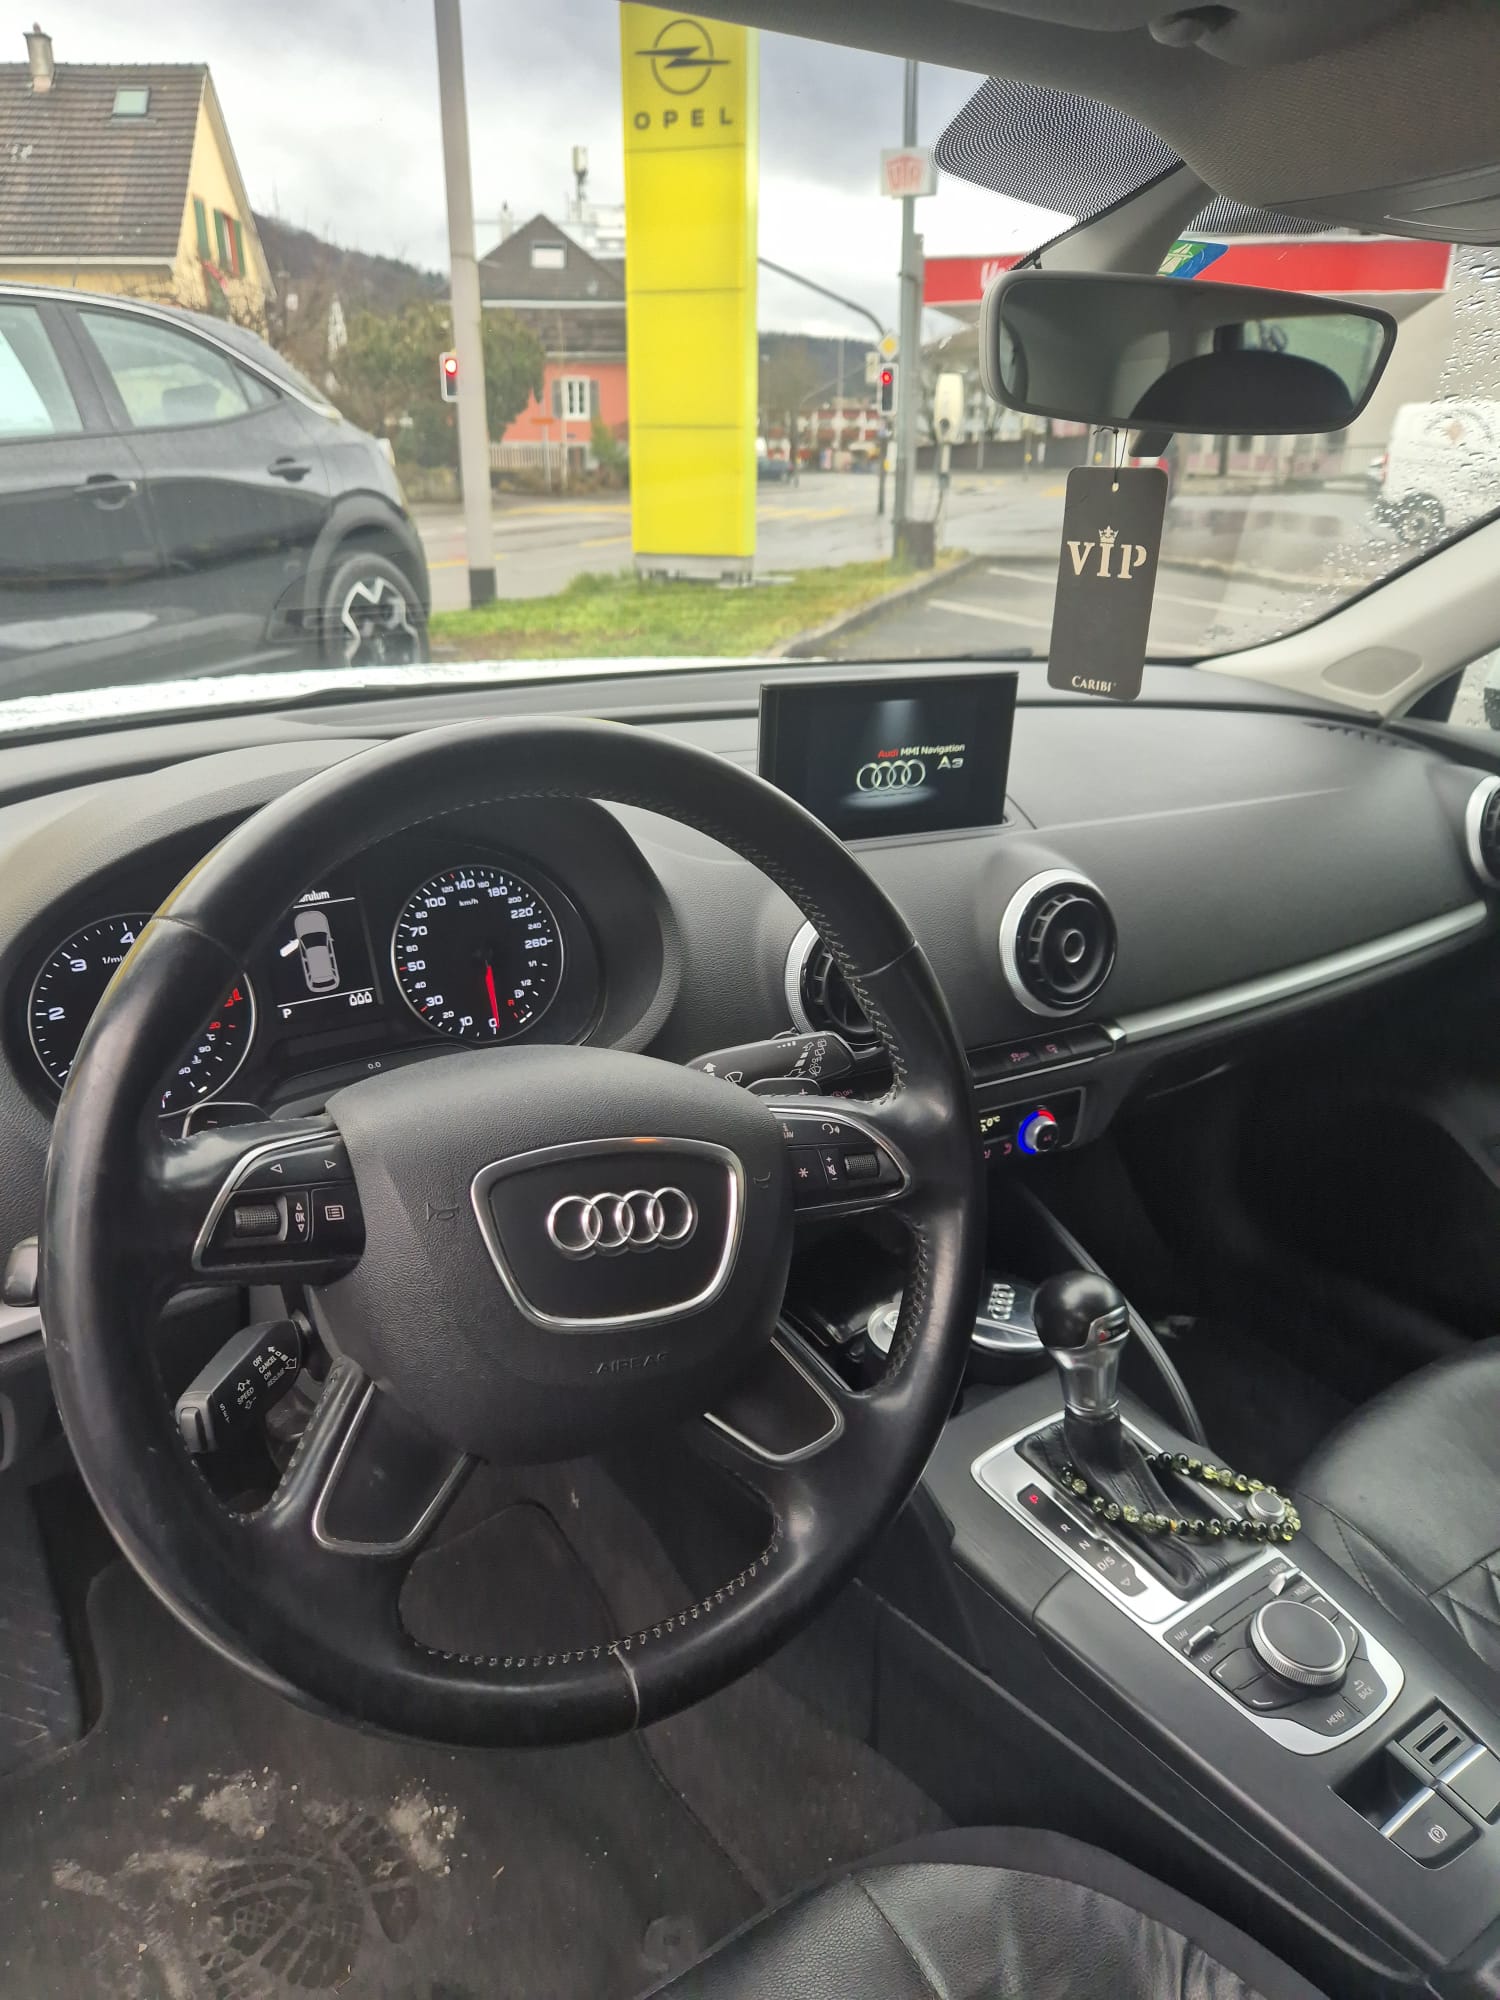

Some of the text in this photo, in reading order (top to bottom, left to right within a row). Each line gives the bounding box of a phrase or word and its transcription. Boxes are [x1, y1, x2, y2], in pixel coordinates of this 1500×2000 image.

[633, 107, 733, 130] OPEL
[1067, 541, 1147, 579] VIP
[878, 743, 966, 759] Audi MMI Navigation
[937, 755, 964, 770] A3
[455, 879, 475, 890] 140
[487, 886, 508, 897] 180
[424, 897, 447, 908] 100
[459, 898, 479, 906] km/h
[508, 896, 522, 904] 200
[510, 907, 533, 919] 220
[409, 925, 428, 937] 70
[527, 922, 542, 930] 240
[120, 931, 135, 944] 4
[524, 937, 548, 949] 260
[69, 958, 87, 972] 3
[407, 960, 426, 971] 50
[414, 981, 427, 989] 40
[426, 995, 444, 1007] 30
[48, 1006, 65, 1021] 2
[282, 1008, 292, 1019] P
[442, 1011, 454, 1019] 20
[459, 1016, 473, 1027] 10
[488, 1018, 498, 1028] 0
[295, 1212, 305, 1223] OK
[252, 1355, 263, 1367] OFF
[258, 1356, 277, 1374] CANCEL
[263, 1370, 272, 1381] ON
[237, 1386, 255, 1405] SPEED
[1061, 1523, 1071, 1533] R
[1079, 1540, 1091, 1550] N
[1096, 1556, 1116, 1571] D/S
[1174, 1628, 1189, 1641] NAV
[1200, 1653, 1214, 1664] TEL
[1326, 1709, 1345, 1726] MENU
